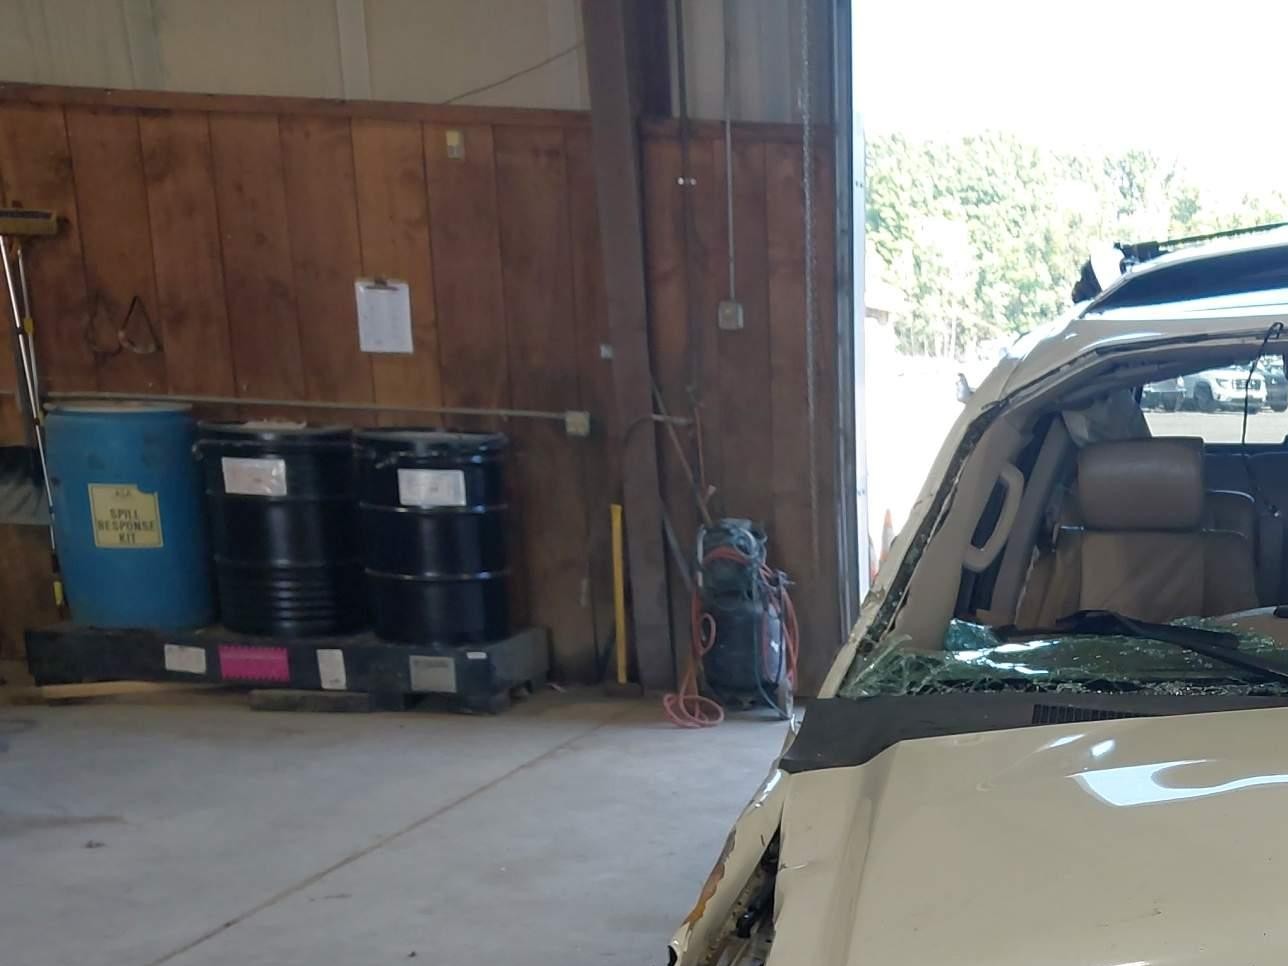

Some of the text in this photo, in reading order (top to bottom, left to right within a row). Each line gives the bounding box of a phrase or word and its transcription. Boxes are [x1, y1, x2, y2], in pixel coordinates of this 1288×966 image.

[109, 508, 139, 519] SPILL
[97, 520, 154, 531] RESPONSE
[119, 532, 136, 544] KIT
